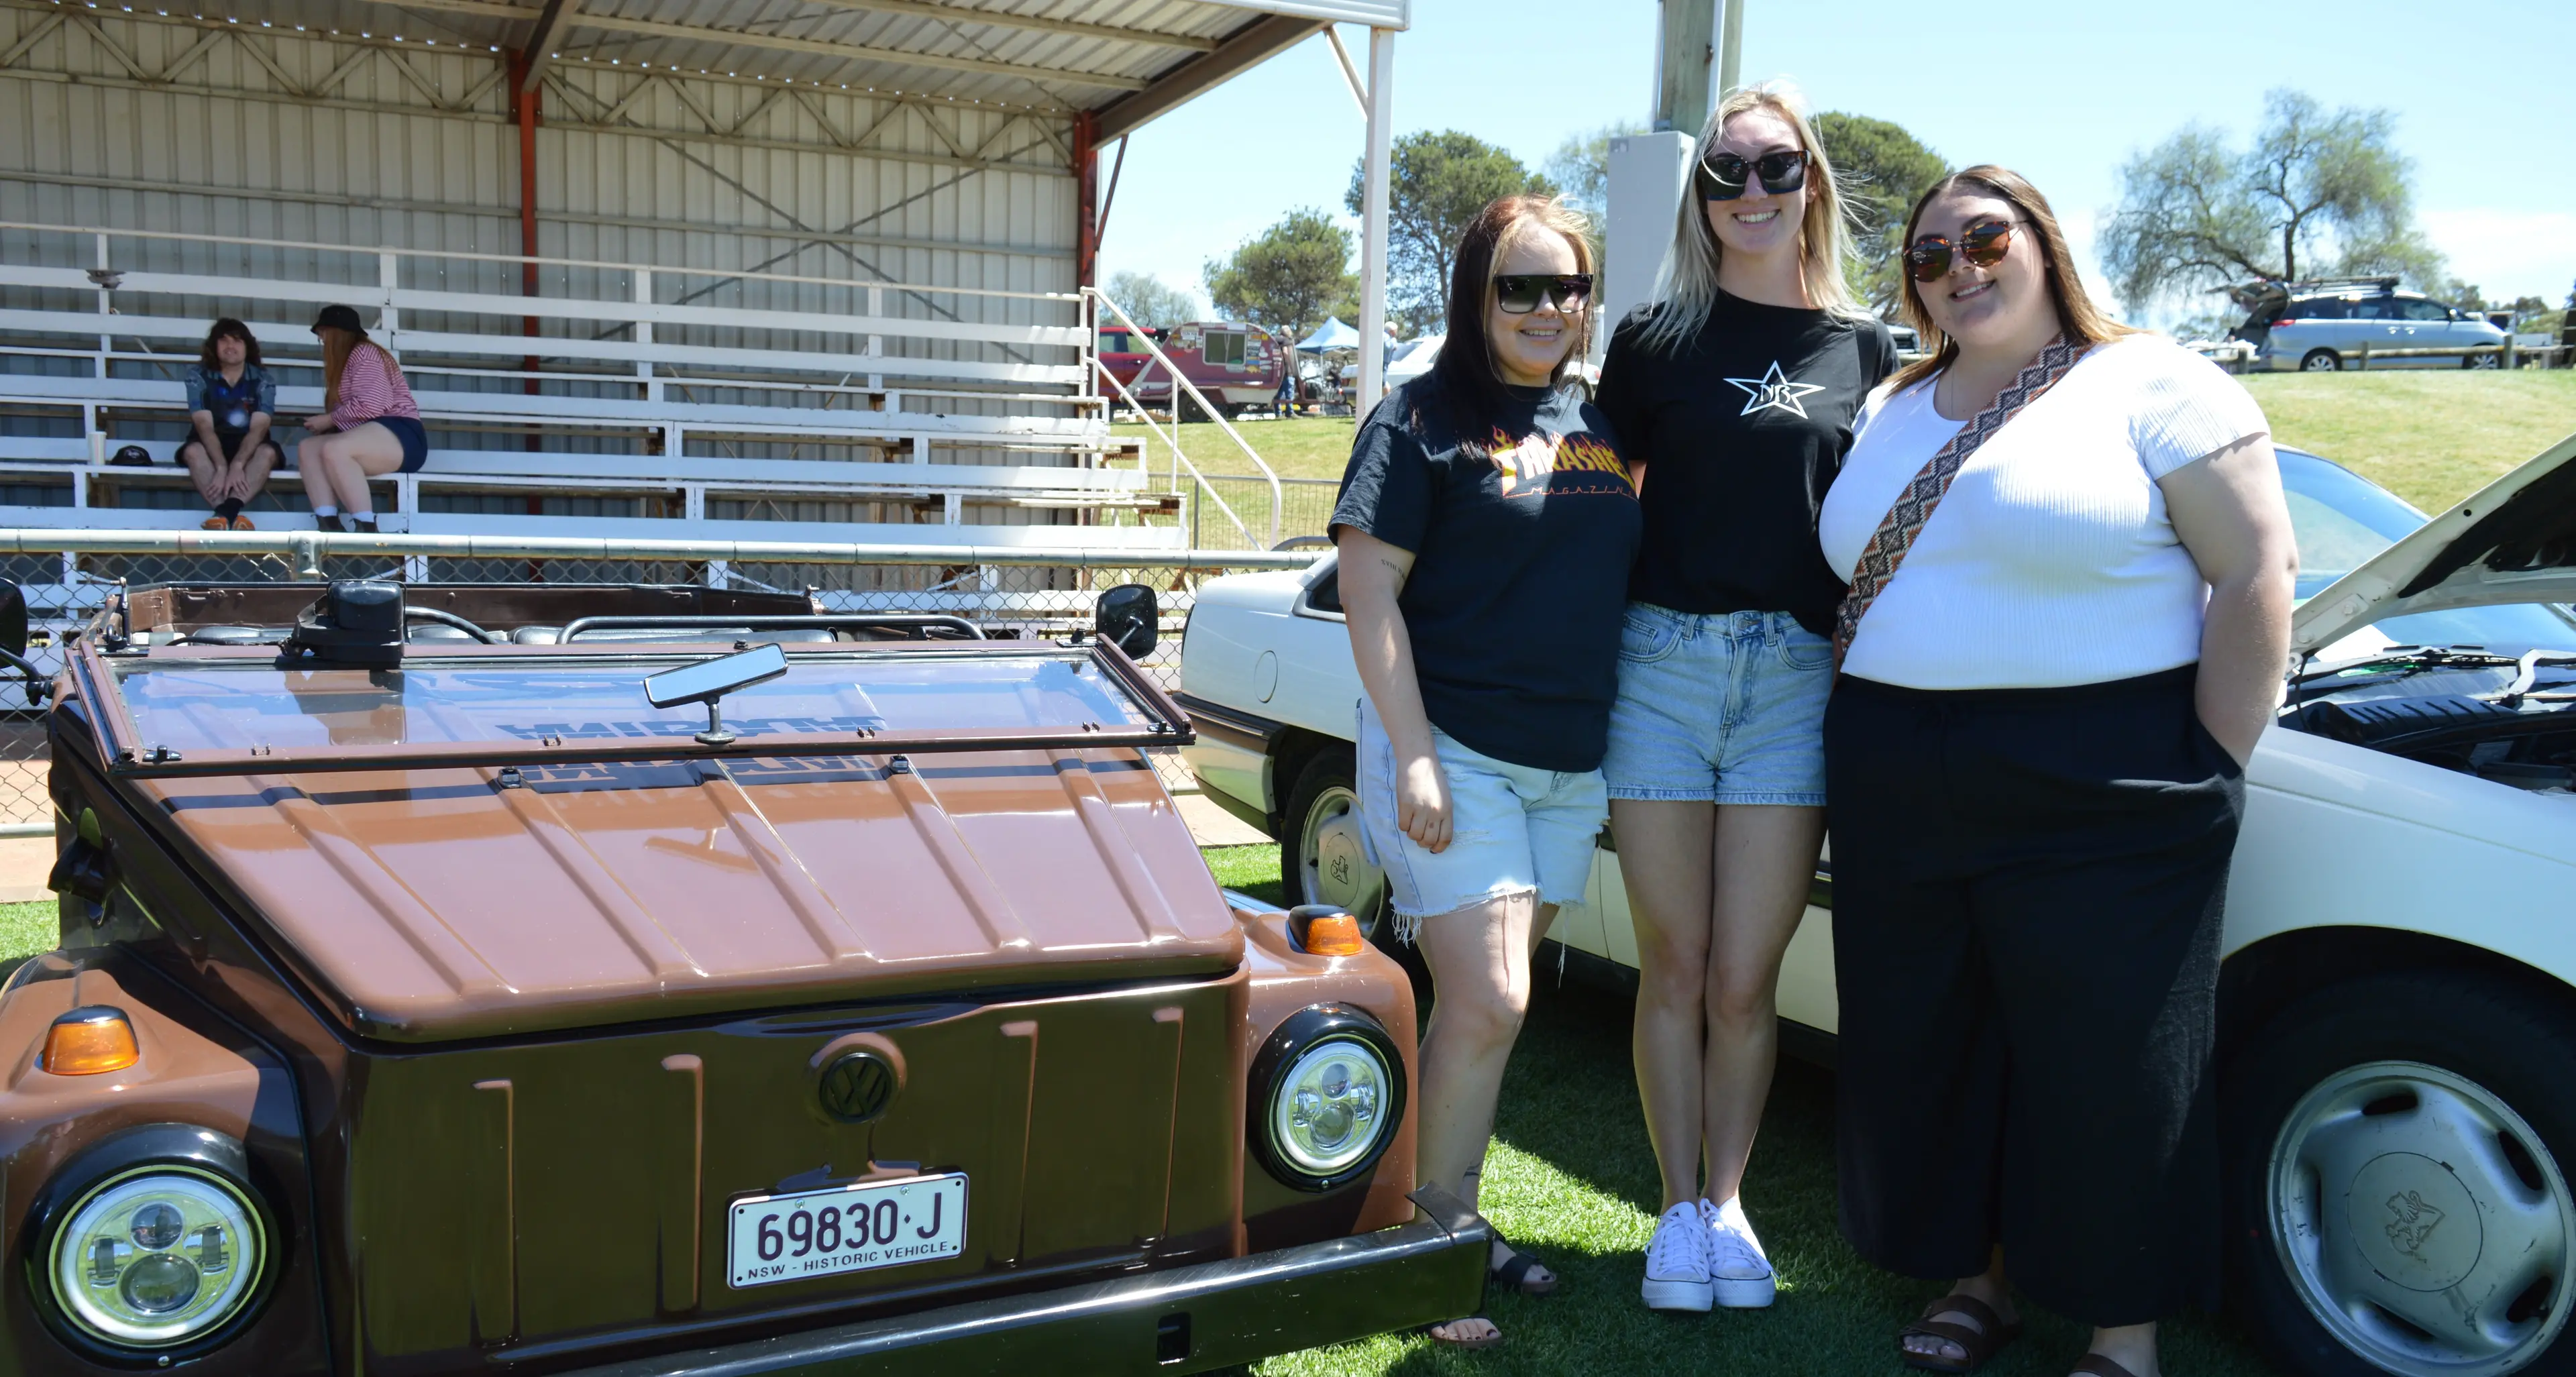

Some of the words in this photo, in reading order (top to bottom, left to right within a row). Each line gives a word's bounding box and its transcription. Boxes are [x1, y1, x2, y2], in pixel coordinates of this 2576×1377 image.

[1491, 431, 1636, 496] THRASHE
[748, 1264, 786, 1280] NSW
[804, 1252, 878, 1272] HISTORIC
[883, 1241, 949, 1260] VEHICLE
